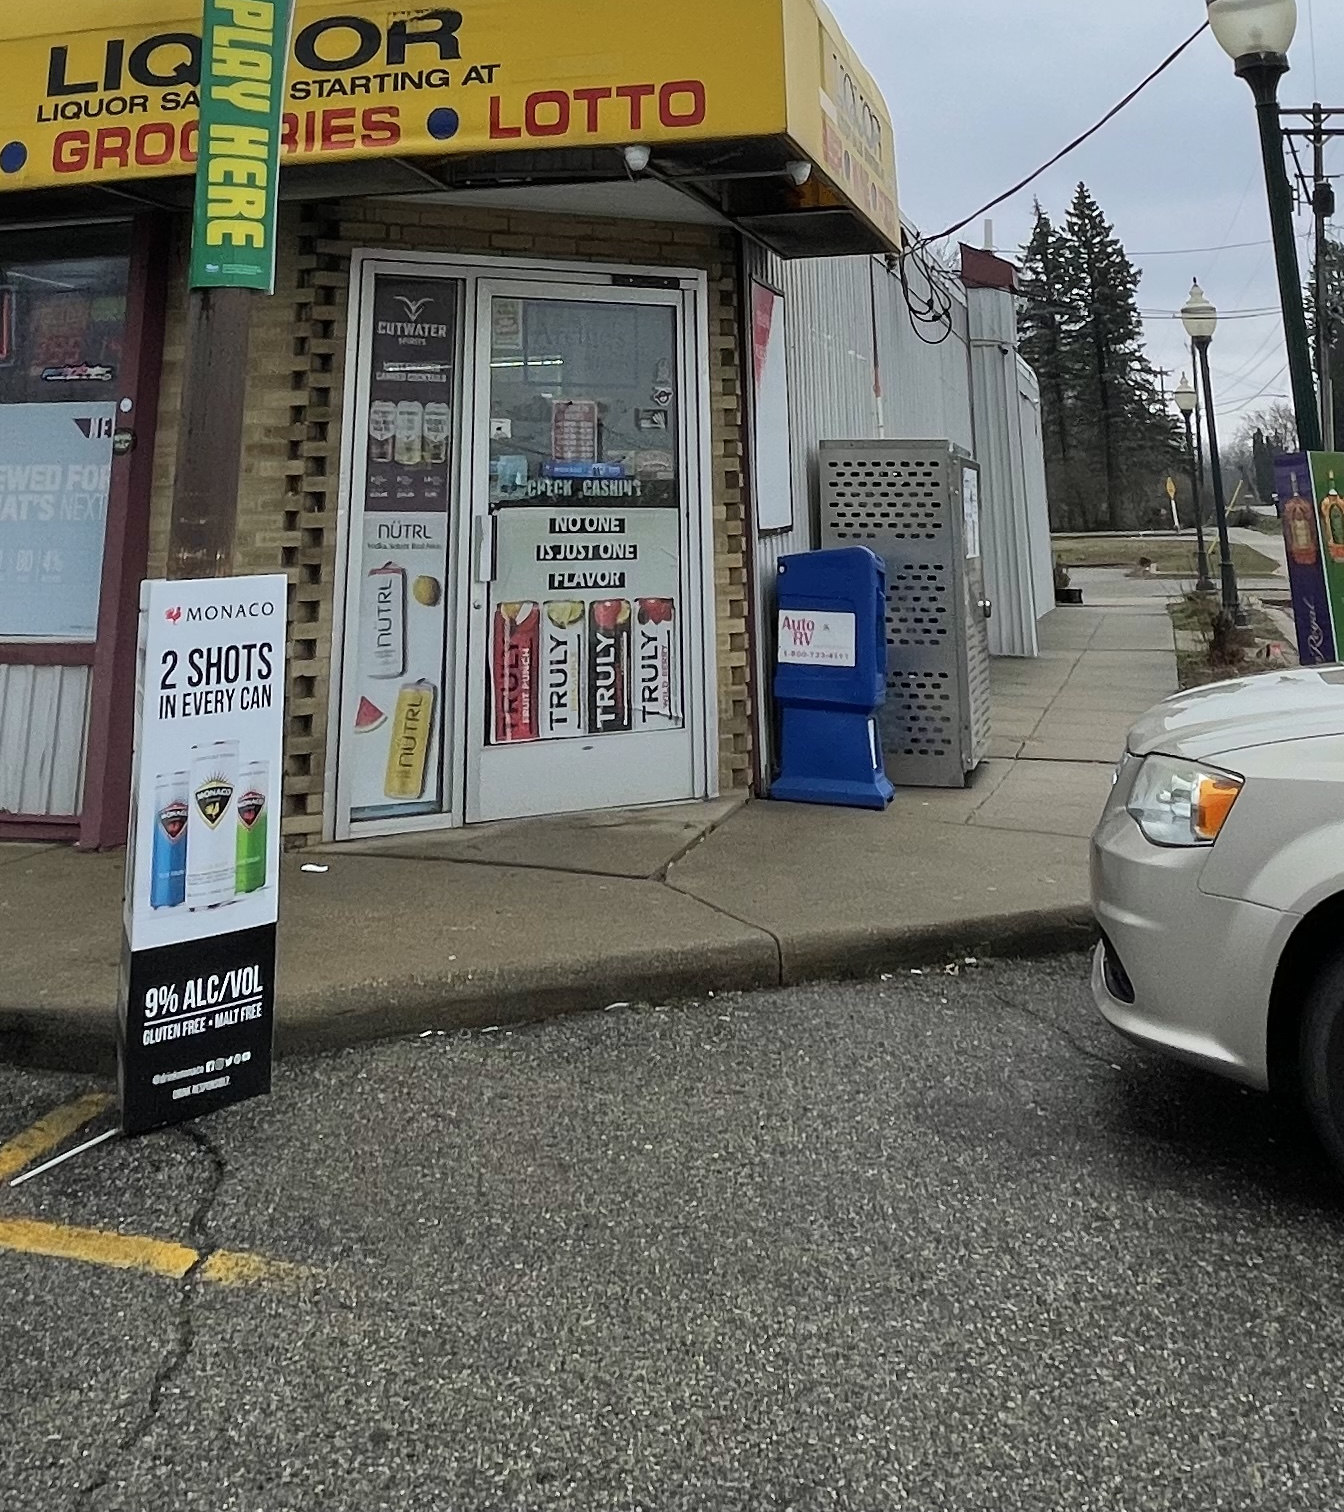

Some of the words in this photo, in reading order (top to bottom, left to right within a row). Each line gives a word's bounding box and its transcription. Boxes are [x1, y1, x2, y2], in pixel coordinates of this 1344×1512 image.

[45, 6, 464, 98] LIQOR
[36, 93, 150, 124] LIQUOR
[290, 68, 451, 101] STARTING
[461, 63, 502, 87] AT
[52, 105, 401, 174] GROCRIES
[489, 79, 707, 140] LOTTO
[205, 122, 273, 250] HERE
[377, 320, 447, 338] CUTWATER
[58, 493, 108, 522] NEXT
[555, 516, 581, 532] NO
[584, 516, 621, 532] ONE
[538, 543, 554, 560] IS
[556, 543, 598, 560] JUST
[599, 543, 636, 560] ONE
[554, 571, 621, 588] FLAVOR
[186, 601, 274, 622] MONACO
[782, 615, 815, 632] Auto
[1303, 595, 1325, 659] Royal
[793, 631, 814, 646] RV
[160, 650, 178, 691] 2
[187, 642, 273, 688] SHOTS
[521, 647, 531, 690] PUNCH
[549, 633, 568, 731] TRULY
[596, 632, 616, 729] TRULY
[641, 629, 660, 724] TRULY
[158, 693, 177, 720] IN
[182, 688, 236, 718] EVERY
[240, 683, 272, 711] CAN
[521, 692, 531, 724] FRUIT
[196, 788, 232, 801] MONACO
[160, 810, 188, 820] MONAC
[144, 983, 179, 1018] 9%
[182, 964, 264, 1010] ALC/VOL
[142, 1022, 181, 1046] GLUTEN
[181, 1016, 207, 1038] FREE
[214, 1007, 240, 1029] MALT
[240, 1001, 263, 1023] FREE
